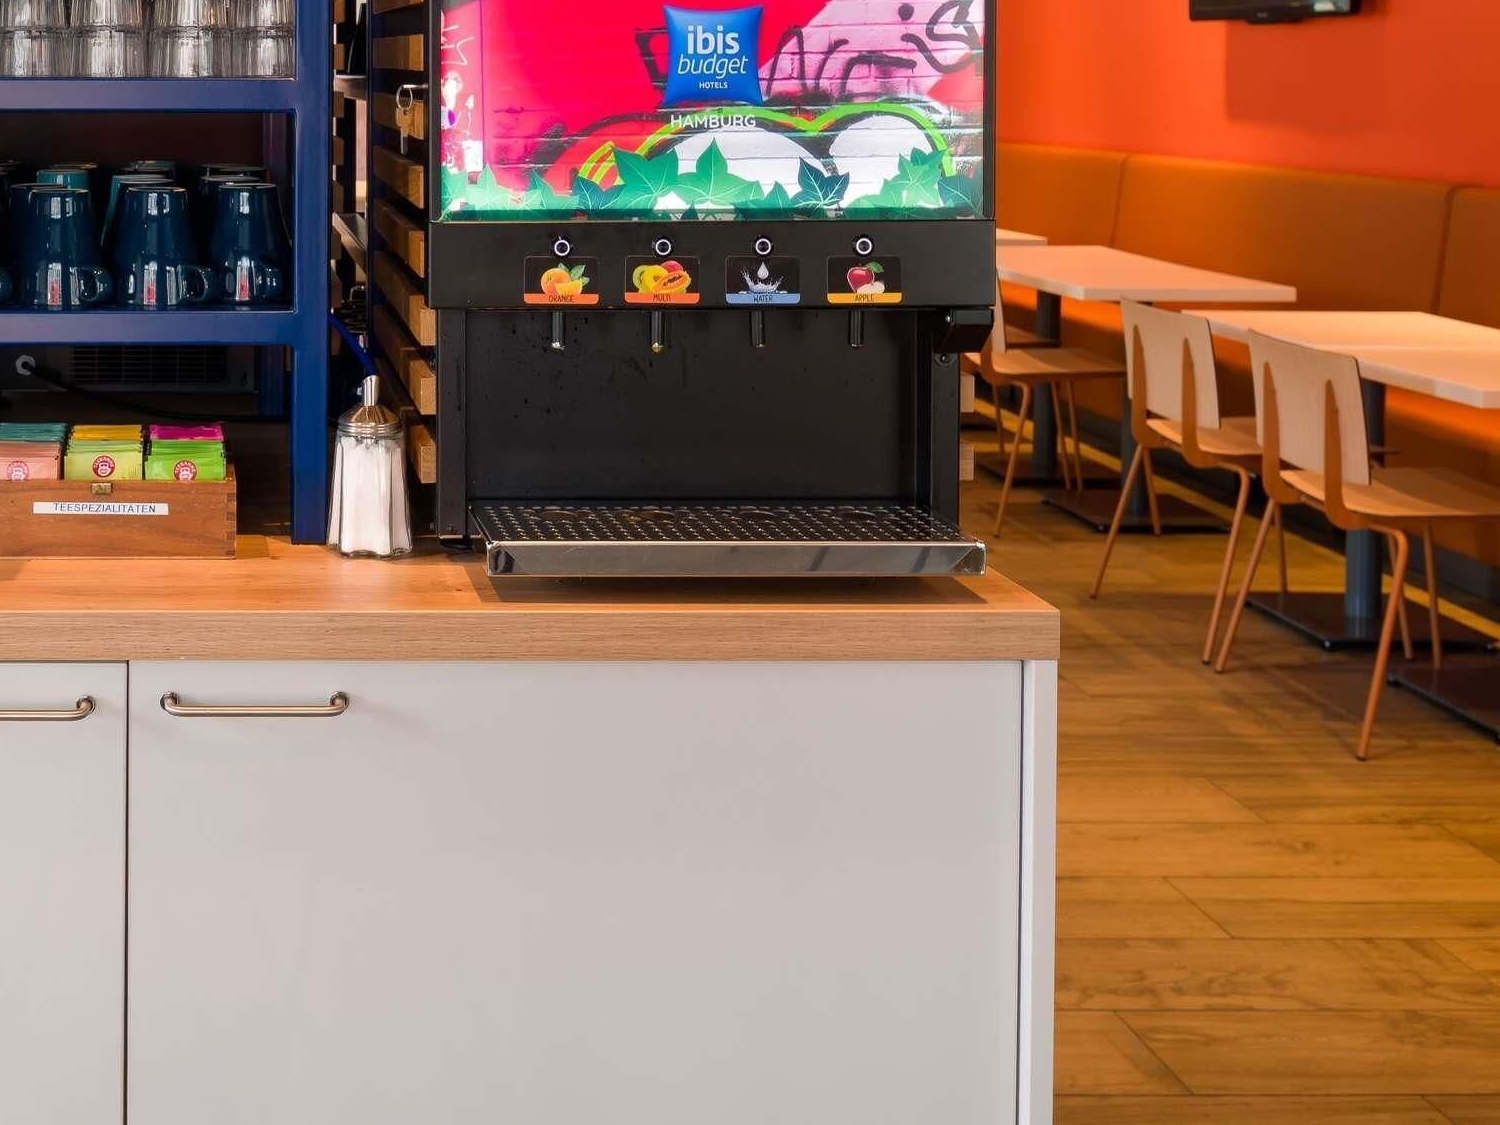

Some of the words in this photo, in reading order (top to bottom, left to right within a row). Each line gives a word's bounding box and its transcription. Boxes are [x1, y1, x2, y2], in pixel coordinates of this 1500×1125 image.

[687, 25, 740, 55] ibis
[677, 53, 749, 80] budget
[699, 81, 728, 89] HOTELS
[670, 114, 756, 129] HAMBURG
[548, 294, 574, 303] ORANGE
[652, 293, 671, 302] MULTI
[753, 294, 773, 302] WATER
[854, 293, 875, 302] APPLE
